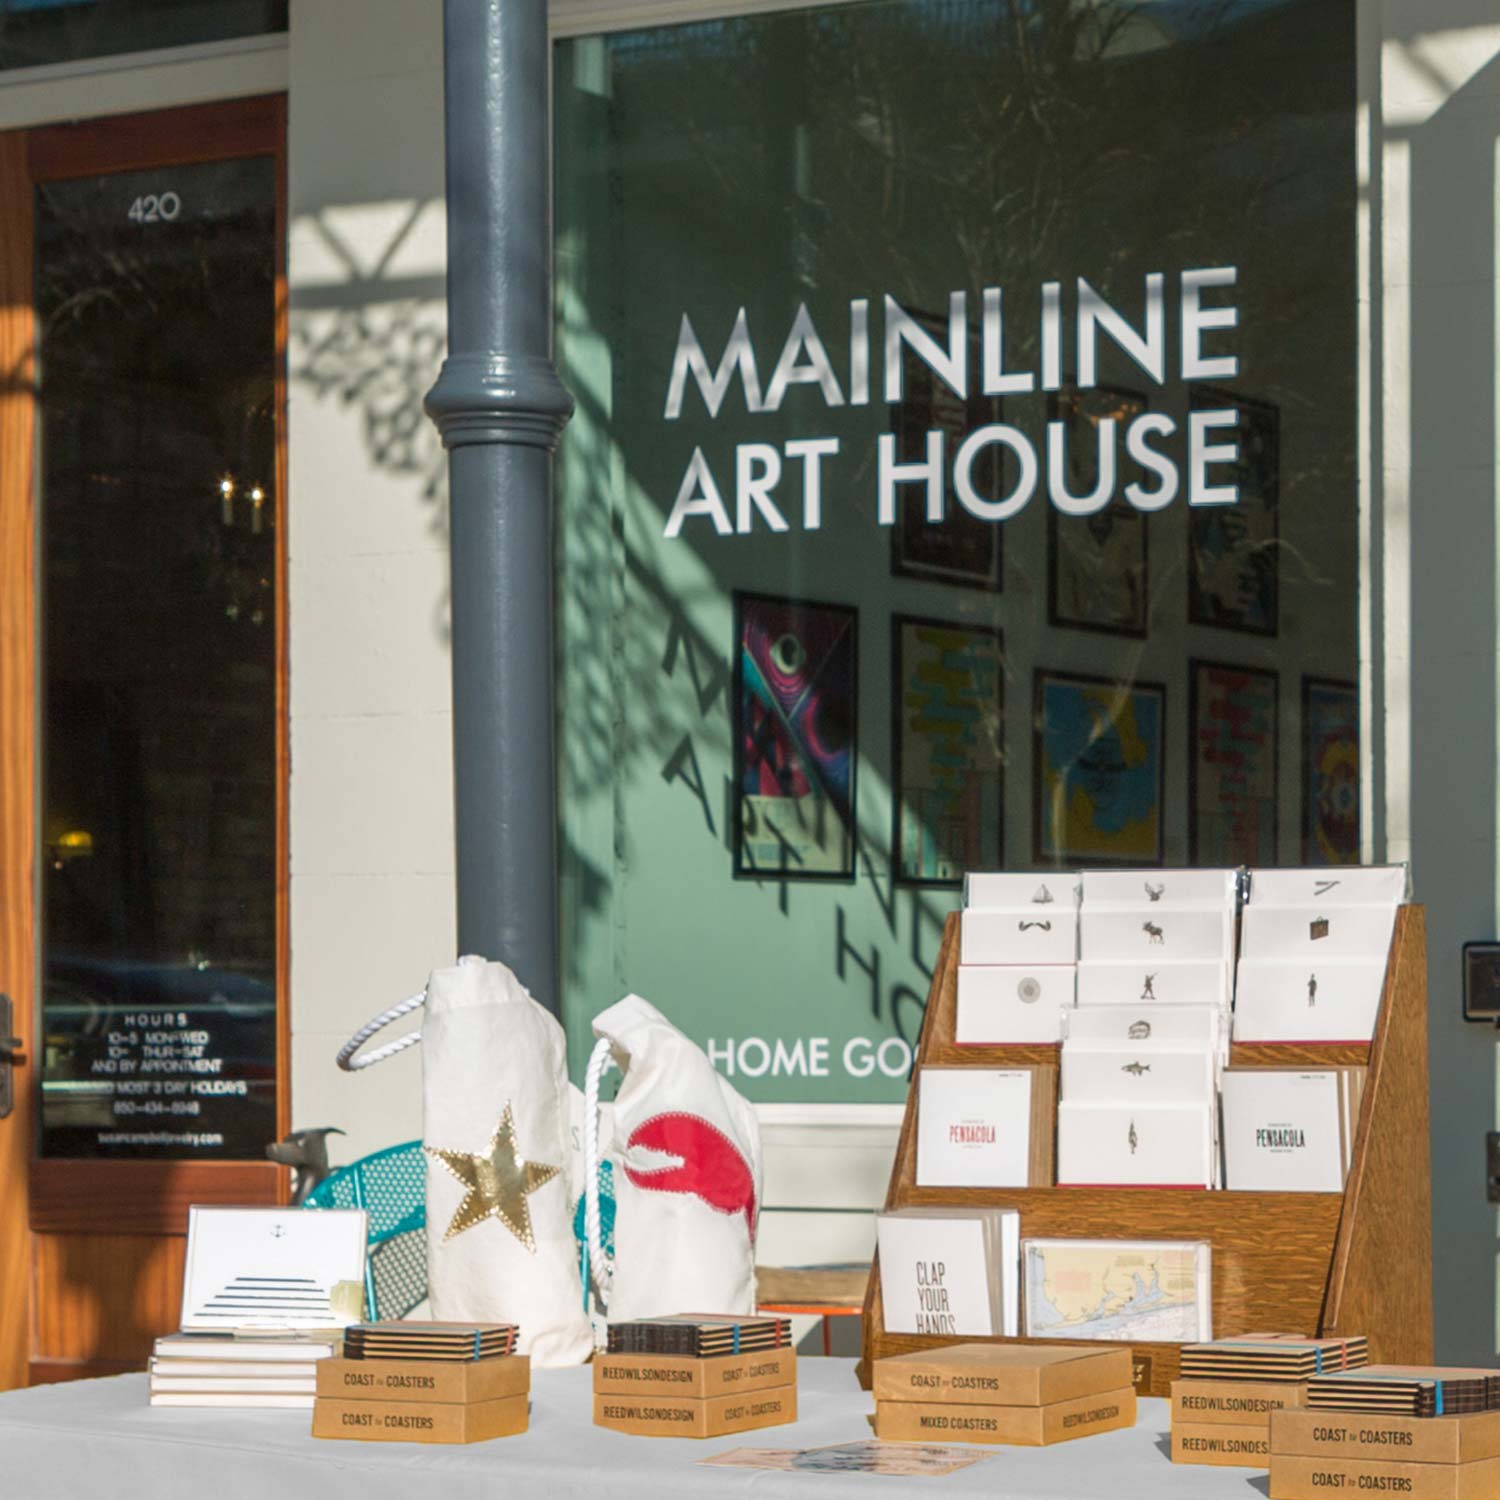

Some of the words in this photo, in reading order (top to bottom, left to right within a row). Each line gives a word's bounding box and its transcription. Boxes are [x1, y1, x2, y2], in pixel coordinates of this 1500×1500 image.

[128, 193, 180, 222] 420
[664, 267, 1239, 419] MAINLINE
[663, 438, 839, 537] ART
[878, 409, 1239, 525] HOUSE
[124, 1013, 188, 1027] HOURS
[707, 1037, 828, 1076] HOME
[843, 1036, 919, 1077] GO
[91, 1060, 115, 1073] AND
[120, 1060, 137, 1073] BY
[140, 1058, 223, 1072] APPOINTMENT
[117, 1081, 149, 1094] MOST
[164, 1081, 186, 1094] DAY
[191, 1080, 247, 1095] HOLIDAYS
[949, 1125, 995, 1143] PENSACOLA
[1256, 1129, 1305, 1148] PENSACOLA
[916, 1261, 945, 1286] CLAP
[917, 1287, 949, 1312] YOUR
[916, 1313, 956, 1335] HANDS
[344, 1373, 374, 1386] COAST
[386, 1375, 435, 1389] COASTERS
[603, 1367, 693, 1383] REEDWILSONDESIGN
[911, 1375, 940, 1388] COAST
[952, 1376, 999, 1390] COASTERS
[1182, 1396, 1284, 1412] REEDWILSONDESIGN
[342, 1413, 373, 1426] COAST
[384, 1415, 433, 1429] COASTERS
[604, 1406, 694, 1422] REEDWILSONDESIGN
[920, 1416, 948, 1428] MIXED
[950, 1417, 998, 1431] COASTERS
[1313, 1427, 1347, 1442] COAST
[1360, 1430, 1413, 1446] COASTERS
[1182, 1438, 1268, 1454] REEDWILSONDES
[1312, 1472, 1345, 1487] COAST
[1358, 1475, 1412, 1492] COASTERS
